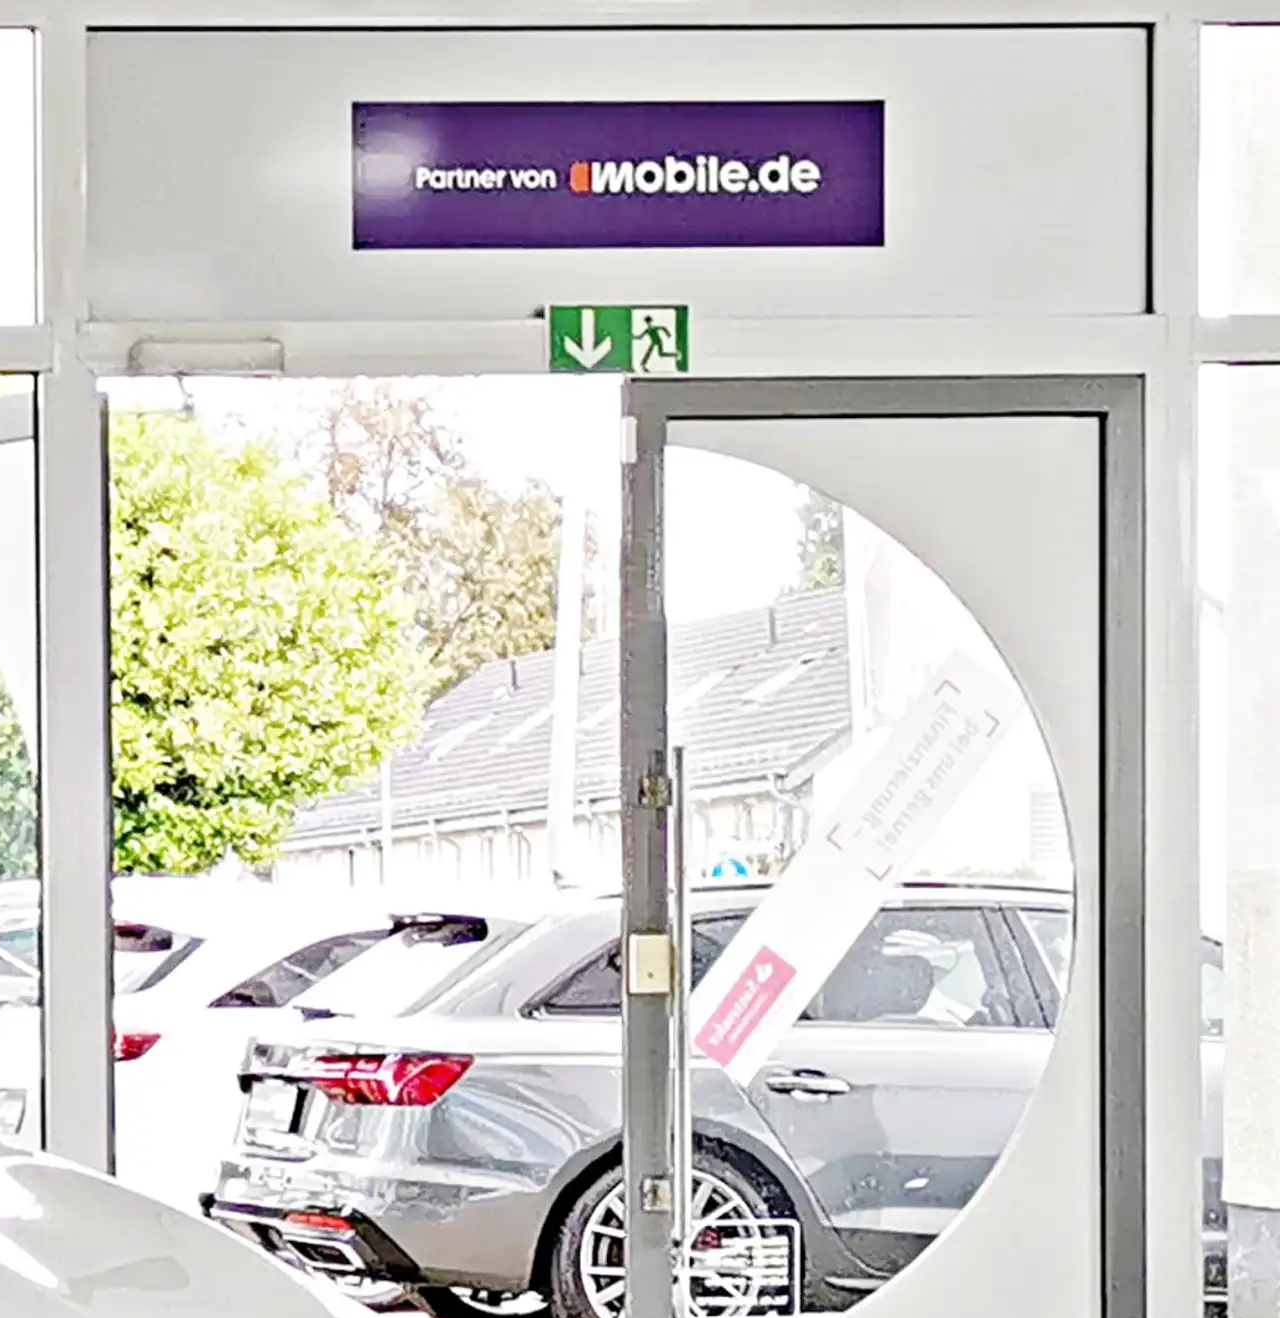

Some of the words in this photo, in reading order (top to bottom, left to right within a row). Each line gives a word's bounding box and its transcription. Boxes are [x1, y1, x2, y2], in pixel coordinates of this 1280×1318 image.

[415, 165, 508, 191] Partner
[511, 169, 557, 190] von
[590, 154, 822, 194] mobile.de
